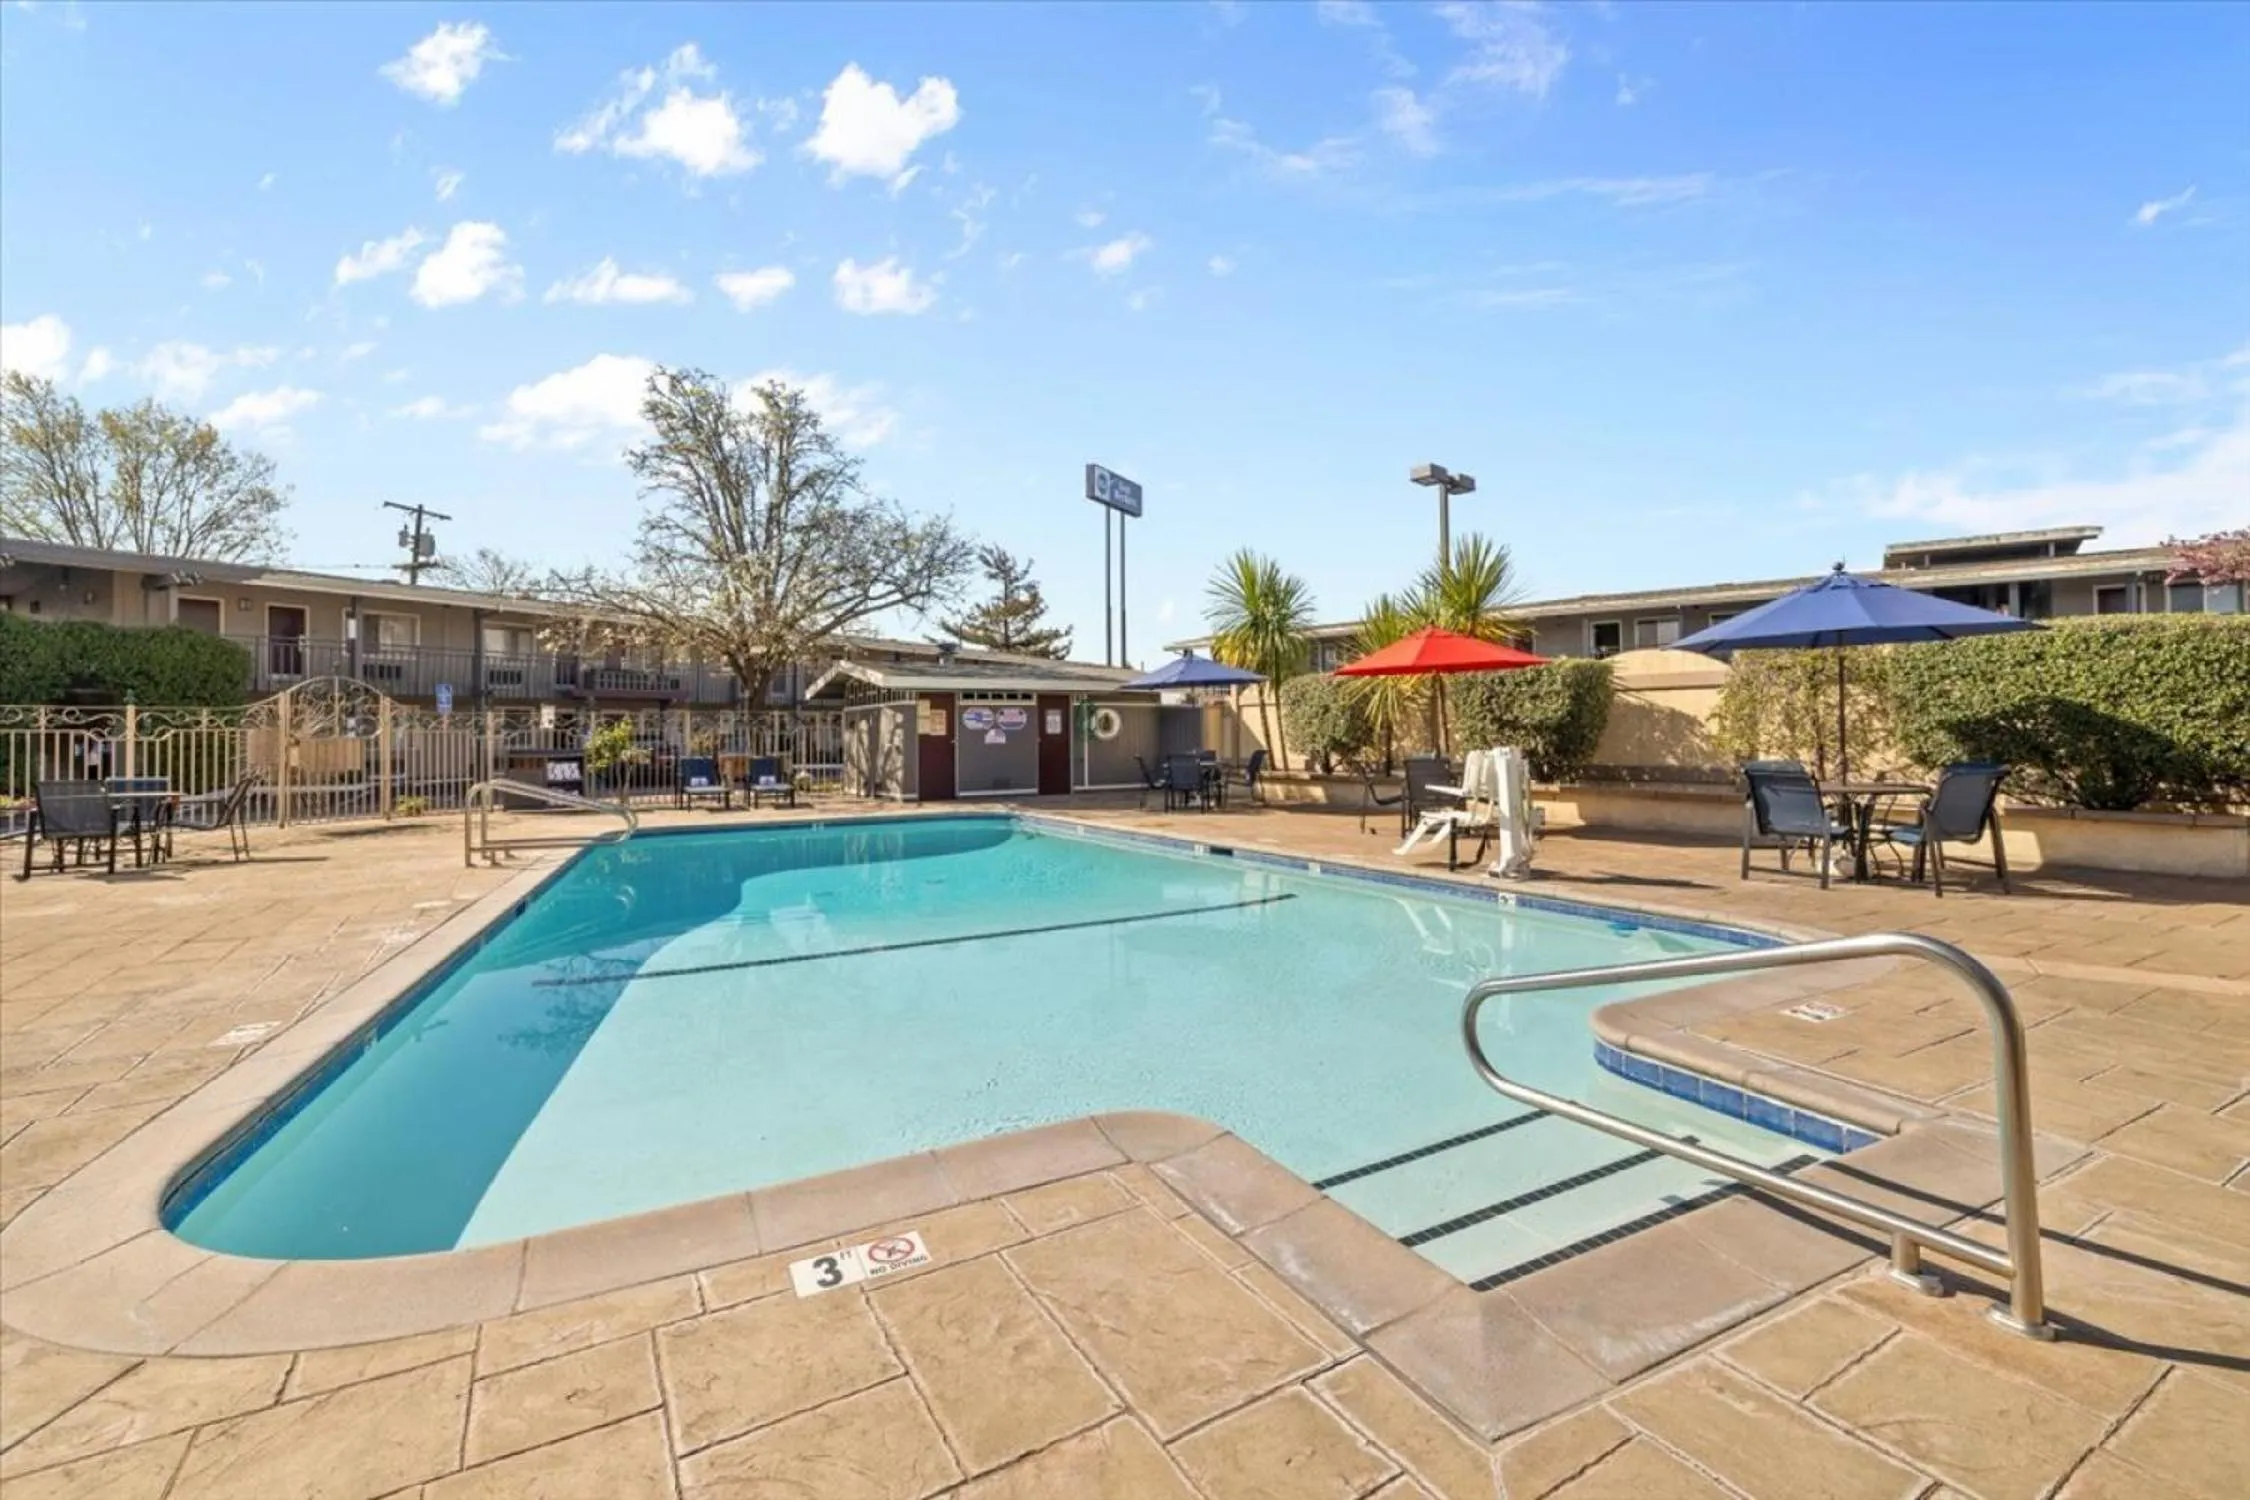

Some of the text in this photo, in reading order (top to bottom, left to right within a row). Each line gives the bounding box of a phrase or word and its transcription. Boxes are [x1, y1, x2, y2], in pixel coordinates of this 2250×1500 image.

[812, 1256, 843, 1288] 3
[870, 1254, 928, 1275] NO DIVING
